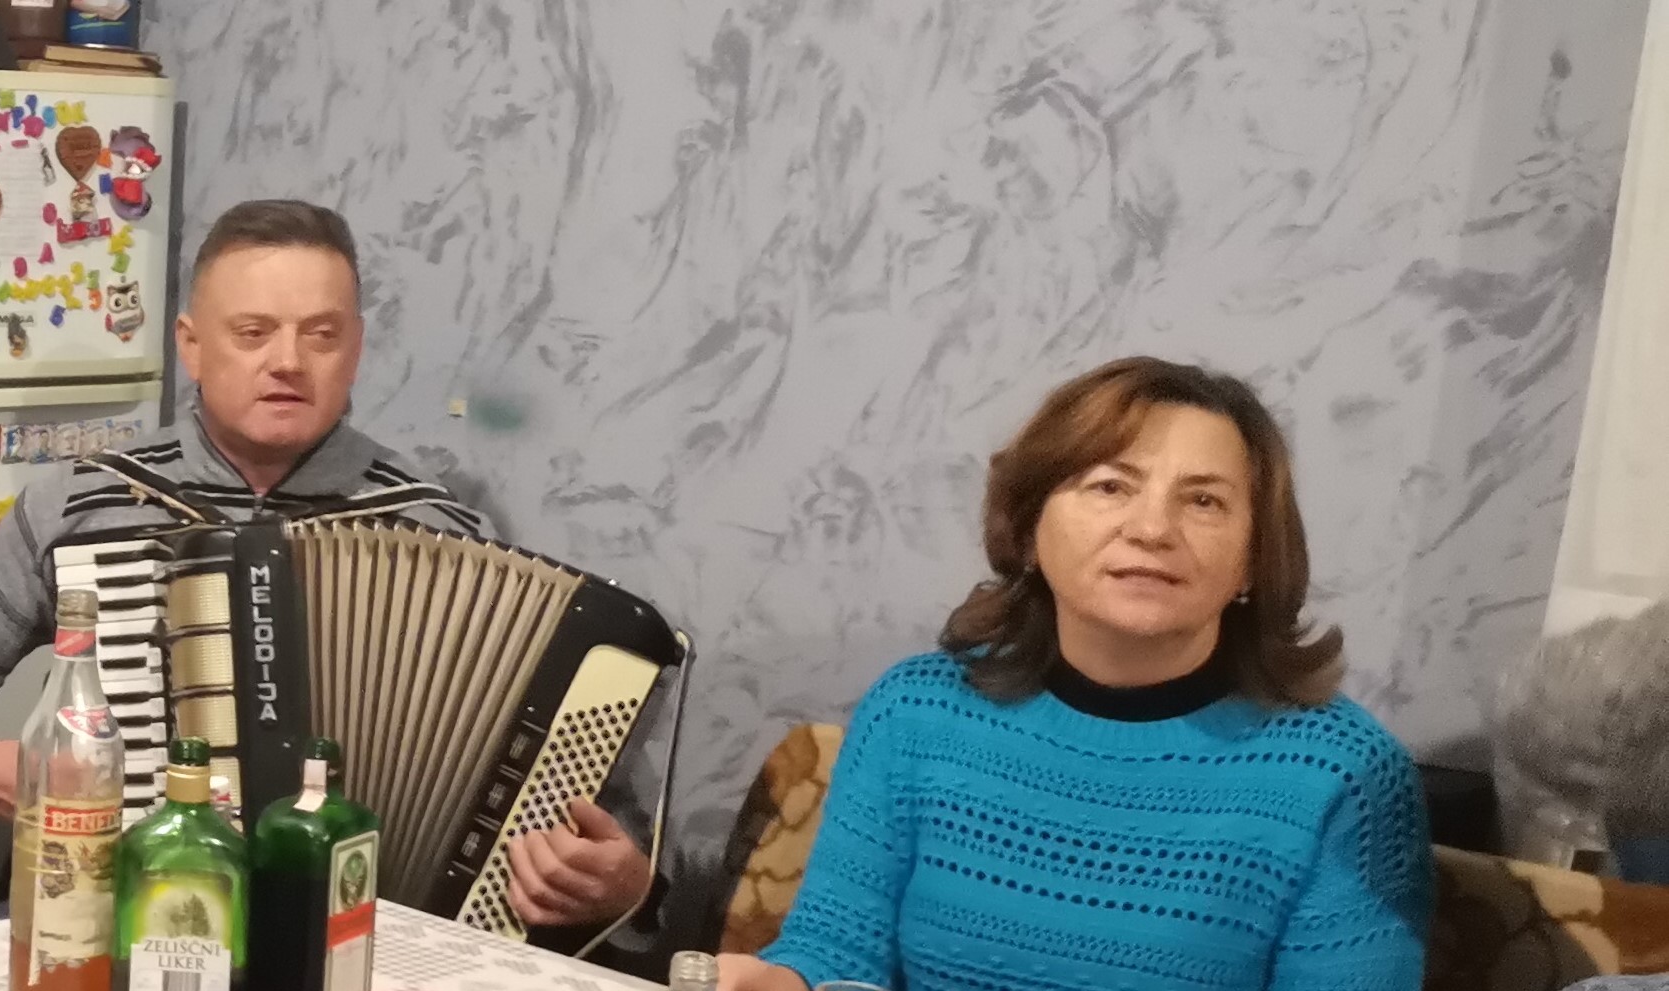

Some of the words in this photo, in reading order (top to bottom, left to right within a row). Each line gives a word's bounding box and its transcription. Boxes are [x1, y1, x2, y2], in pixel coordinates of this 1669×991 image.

[250, 565, 278, 722] MELODIJA
[143, 938, 221, 957] ZELIŠČNI
[158, 955, 206, 970] LIKER
